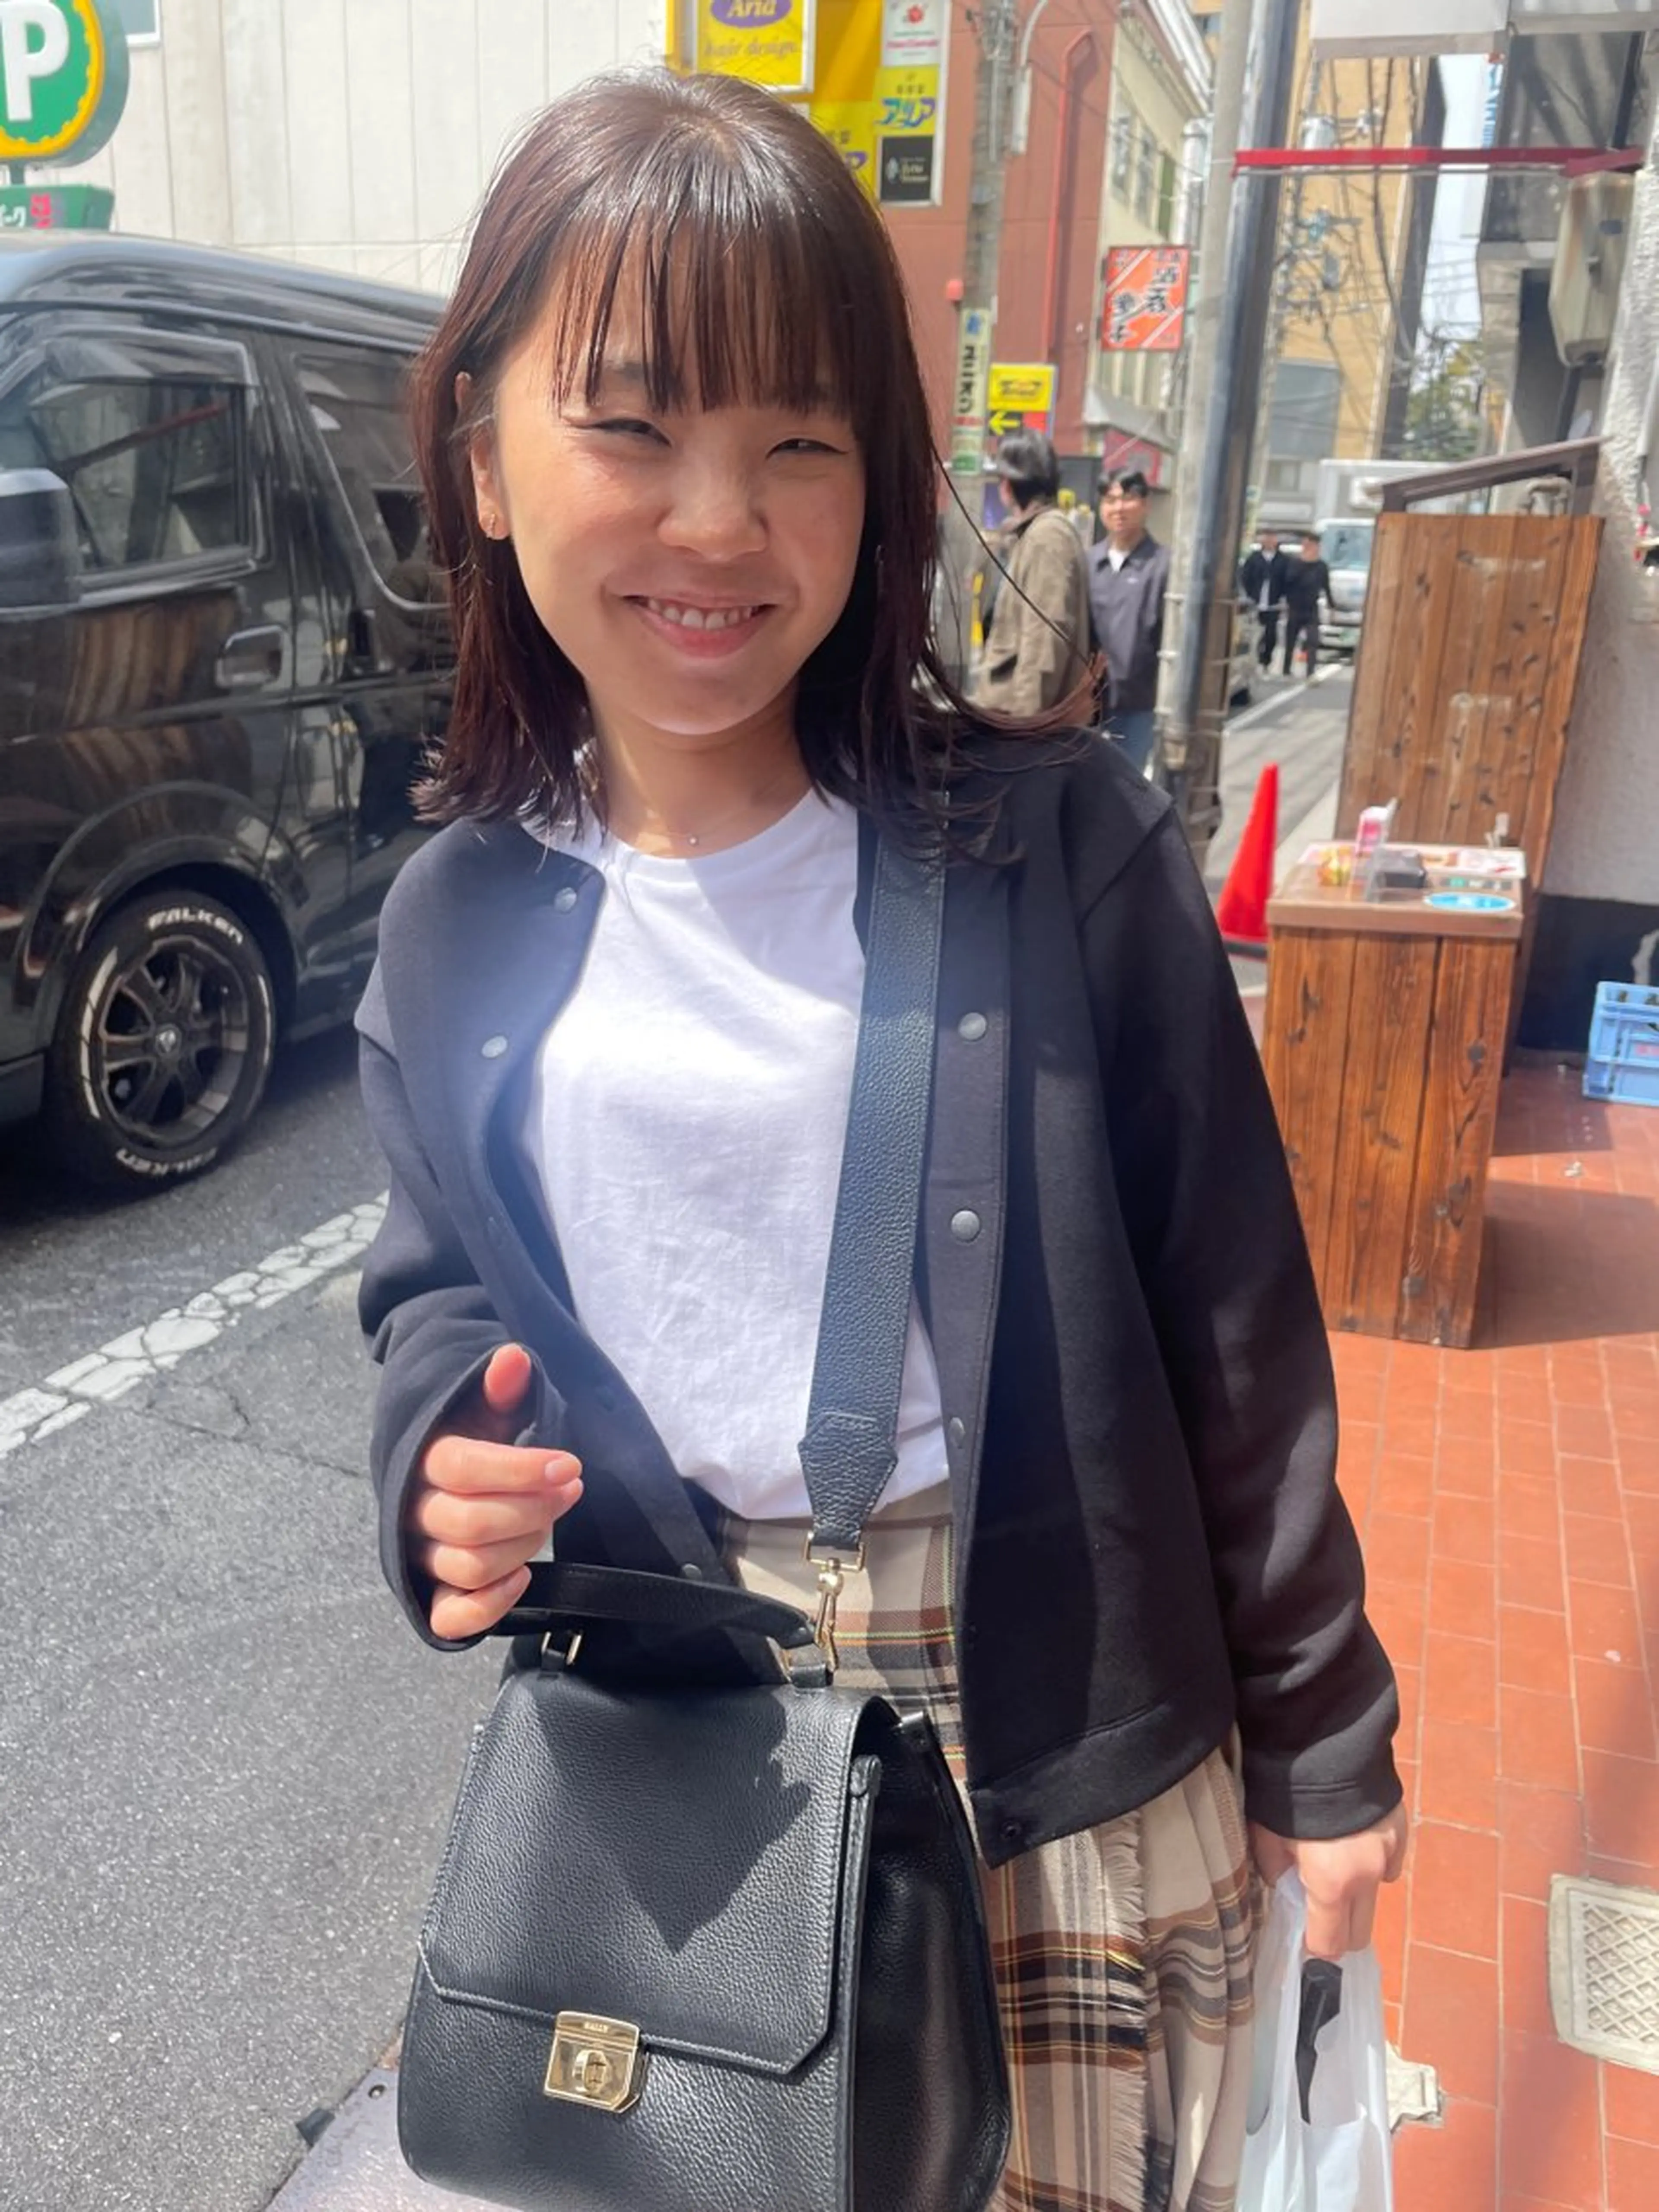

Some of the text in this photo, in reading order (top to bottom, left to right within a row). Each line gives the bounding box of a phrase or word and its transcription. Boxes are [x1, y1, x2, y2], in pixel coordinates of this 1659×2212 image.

[1, 0, 70, 121] P
[704, 36, 796, 61] hair design
[148, 906, 243, 944] FALKEN
